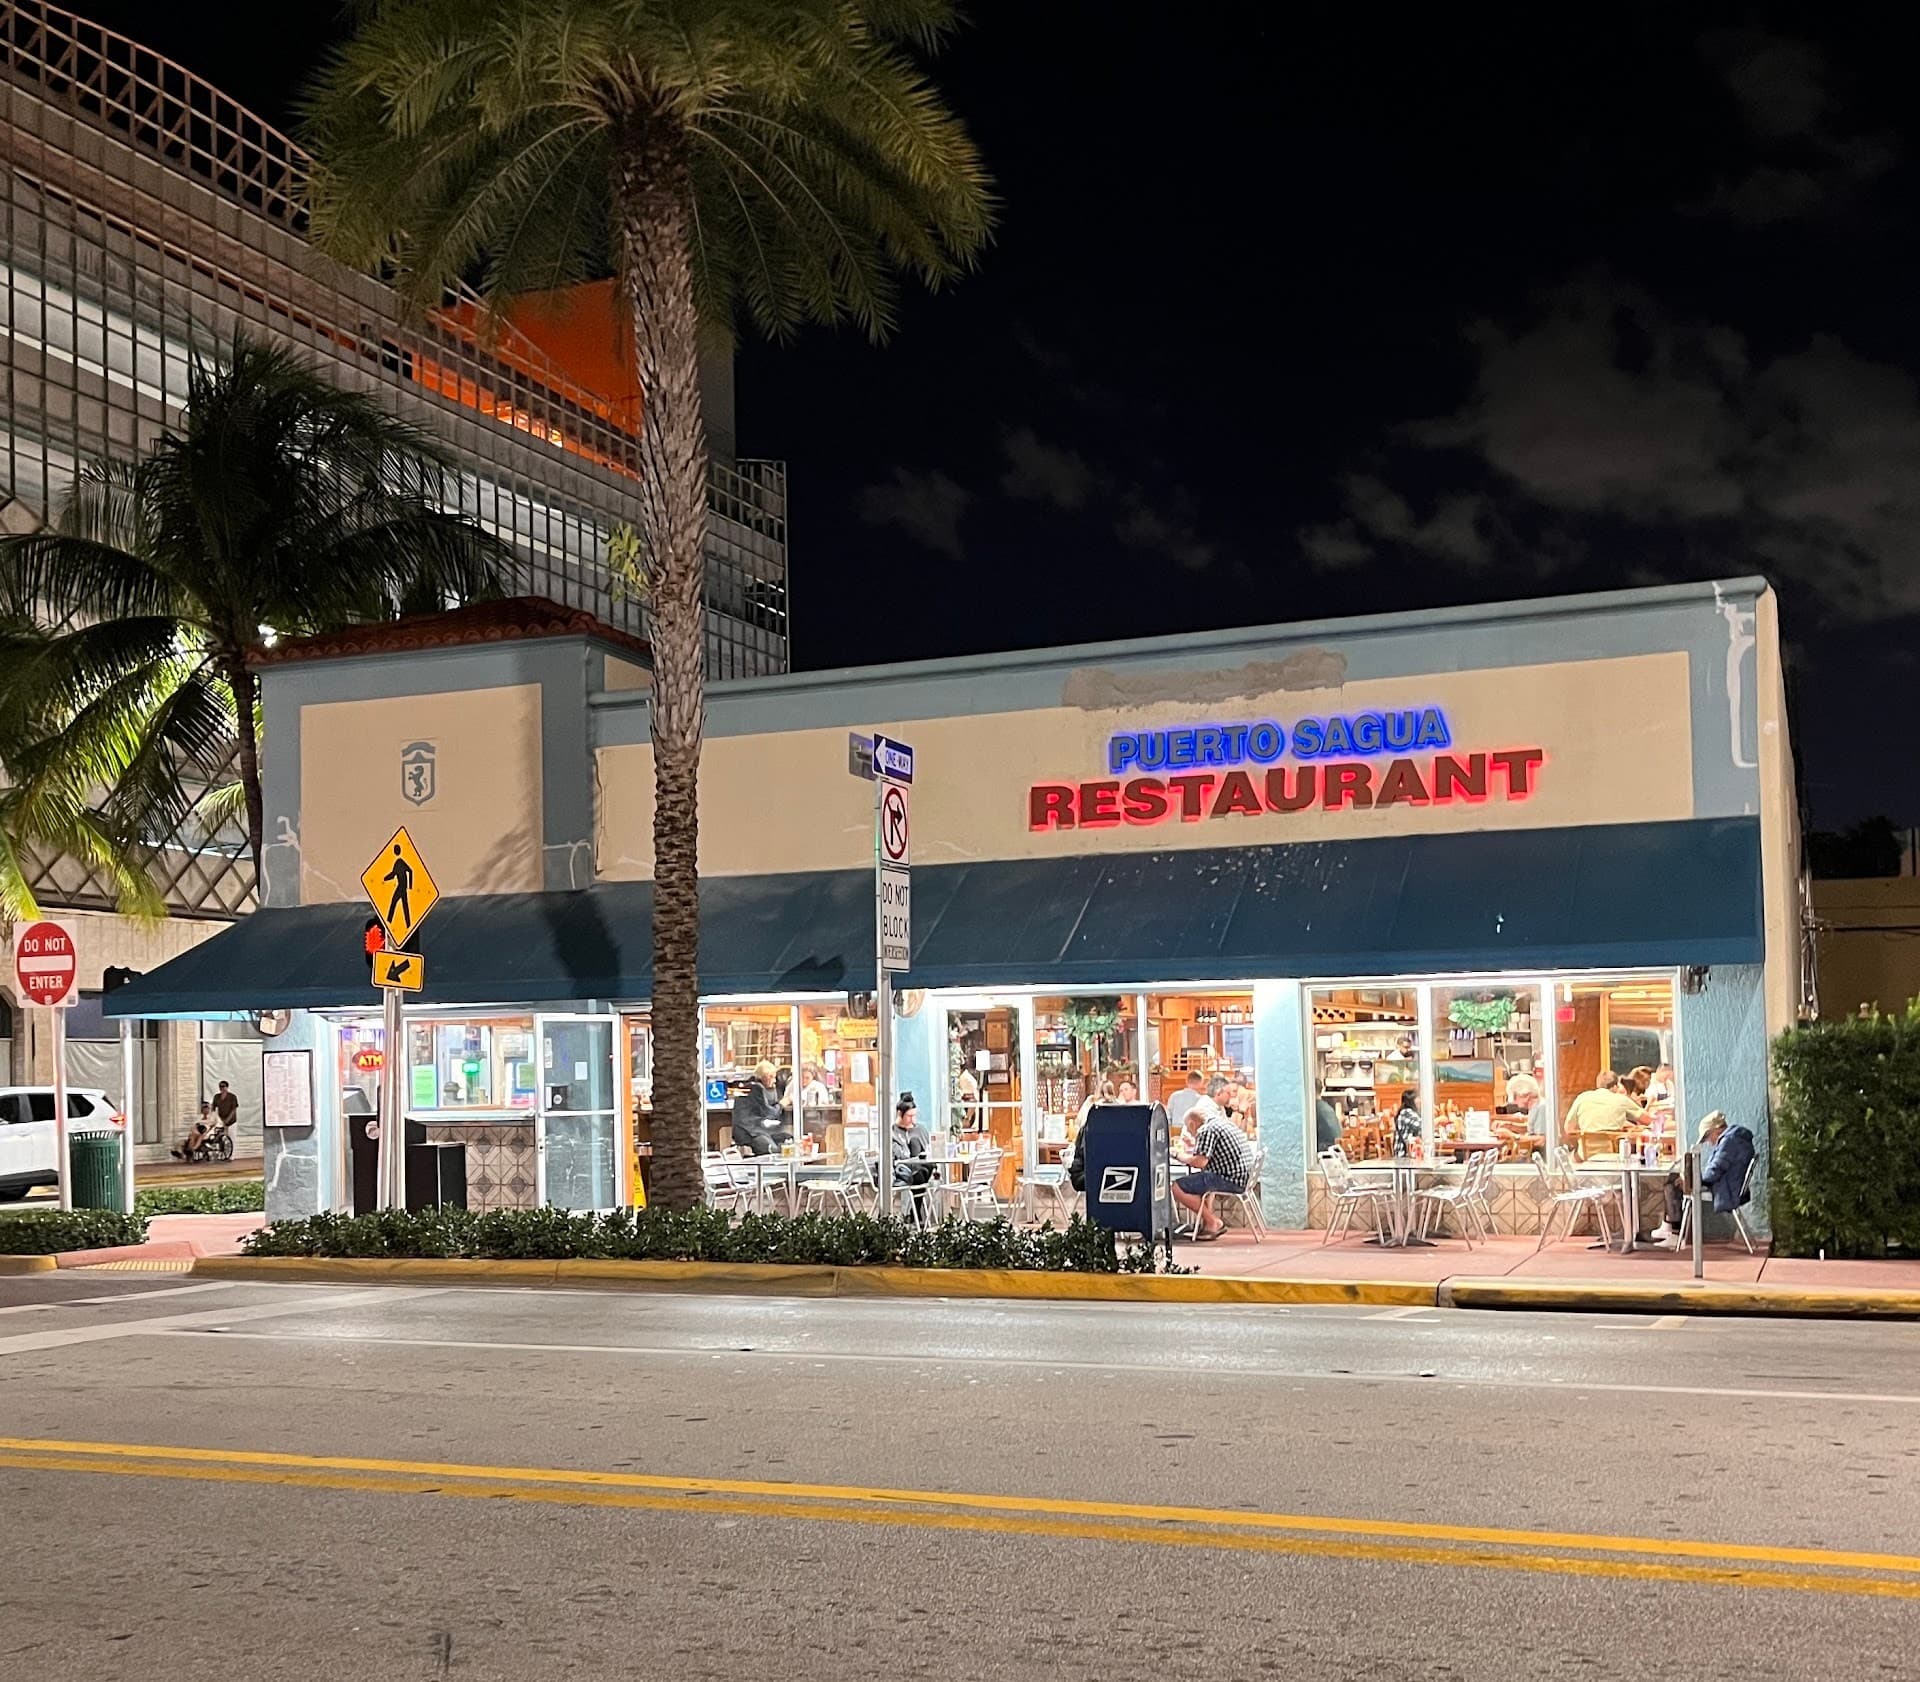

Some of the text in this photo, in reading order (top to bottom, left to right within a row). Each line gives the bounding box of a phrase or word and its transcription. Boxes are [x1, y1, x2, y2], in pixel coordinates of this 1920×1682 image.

[1111, 709, 1447, 770] PUERTO SAGUA
[1030, 749, 1542, 828] RESTAURANT
[883, 882, 909, 906] DO NOT
[883, 915, 909, 938] BLOCK
[24, 937, 66, 952] DO NOT
[29, 975, 63, 990] ENTER
[359, 1054, 383, 1067] ATM
